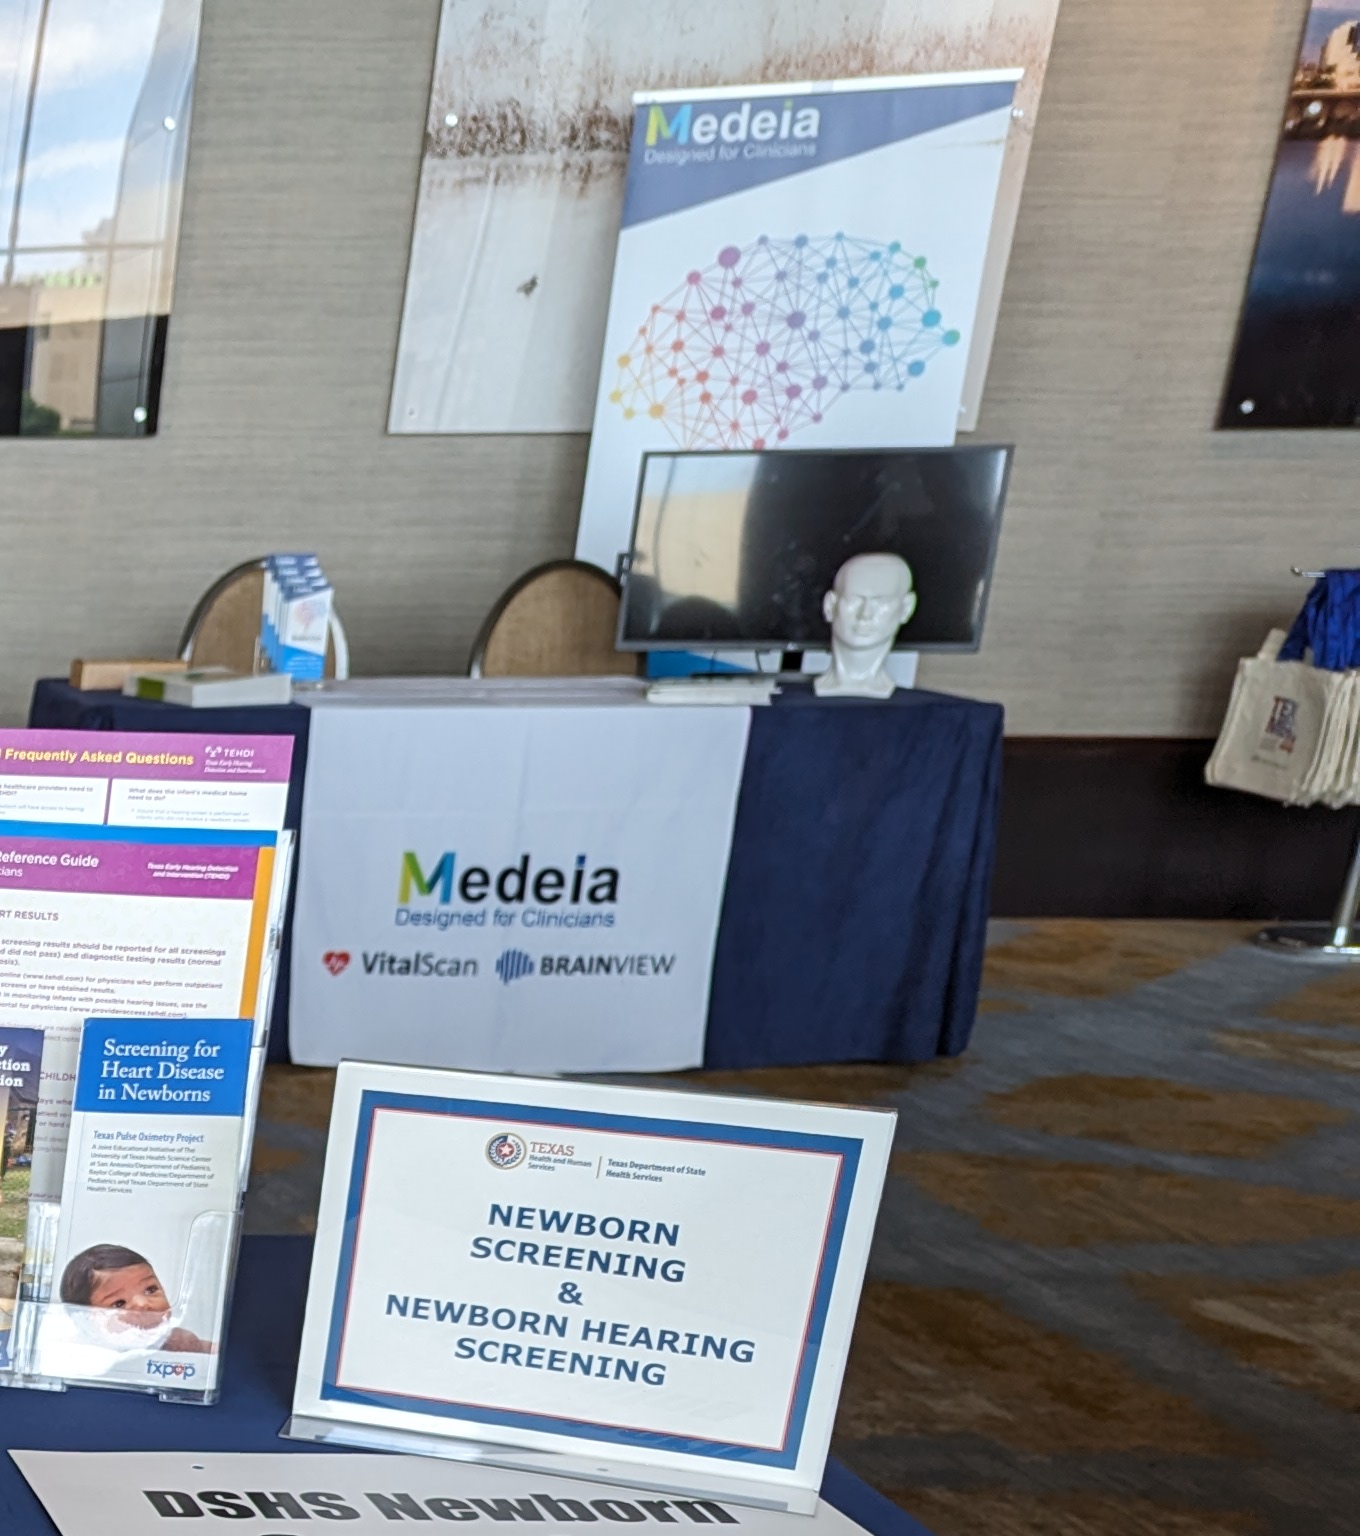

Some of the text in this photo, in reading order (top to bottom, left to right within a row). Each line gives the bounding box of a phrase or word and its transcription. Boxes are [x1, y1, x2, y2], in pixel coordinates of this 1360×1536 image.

[645, 100, 820, 146] Medeia
[644, 142, 816, 165] Designed for Clinicians
[5, 749, 77, 763] Frequently
[80, 750, 122, 764] Asked
[126, 753, 194, 766] Questions
[223, 749, 254, 758] TEHDI
[60, 854, 99, 867] Guide
[398, 851, 620, 904] Medeia
[14, 911, 59, 921] RESULTS
[395, 907, 615, 931] Designed for Clinicians
[1, 937, 41, 948] screening
[43, 941, 70, 949] results
[72, 941, 100, 950] should
[102, 943, 113, 951] be
[115, 944, 152, 953] reported
[181, 948, 226, 957] screenings
[362, 951, 478, 976] VitalScan
[539, 954, 676, 976] BRAINVIEW
[104, 1039, 220, 1061] Screening for
[100, 1060, 224, 1080] Heart Disease
[99, 1084, 210, 1102] in Newborns
[94, 1130, 204, 1144] Texas Pulse Oximetry Project
[530, 1142, 574, 1157] TEXAS
[528, 1162, 555, 1172] Services
[529, 1154, 551, 1163] Health
[567, 1159, 592, 1167] Human
[608, 1158, 706, 1176] Texas Department of State
[606, 1169, 663, 1183] Health Services
[488, 1202, 680, 1246] NEWBORN
[470, 1236, 686, 1283] SCREENING
[558, 1281, 584, 1306] &
[385, 1294, 756, 1364] NEWBORN HEARING
[454, 1338, 667, 1386] SCREENING
[143, 1489, 741, 1524] DSHS Newborn
